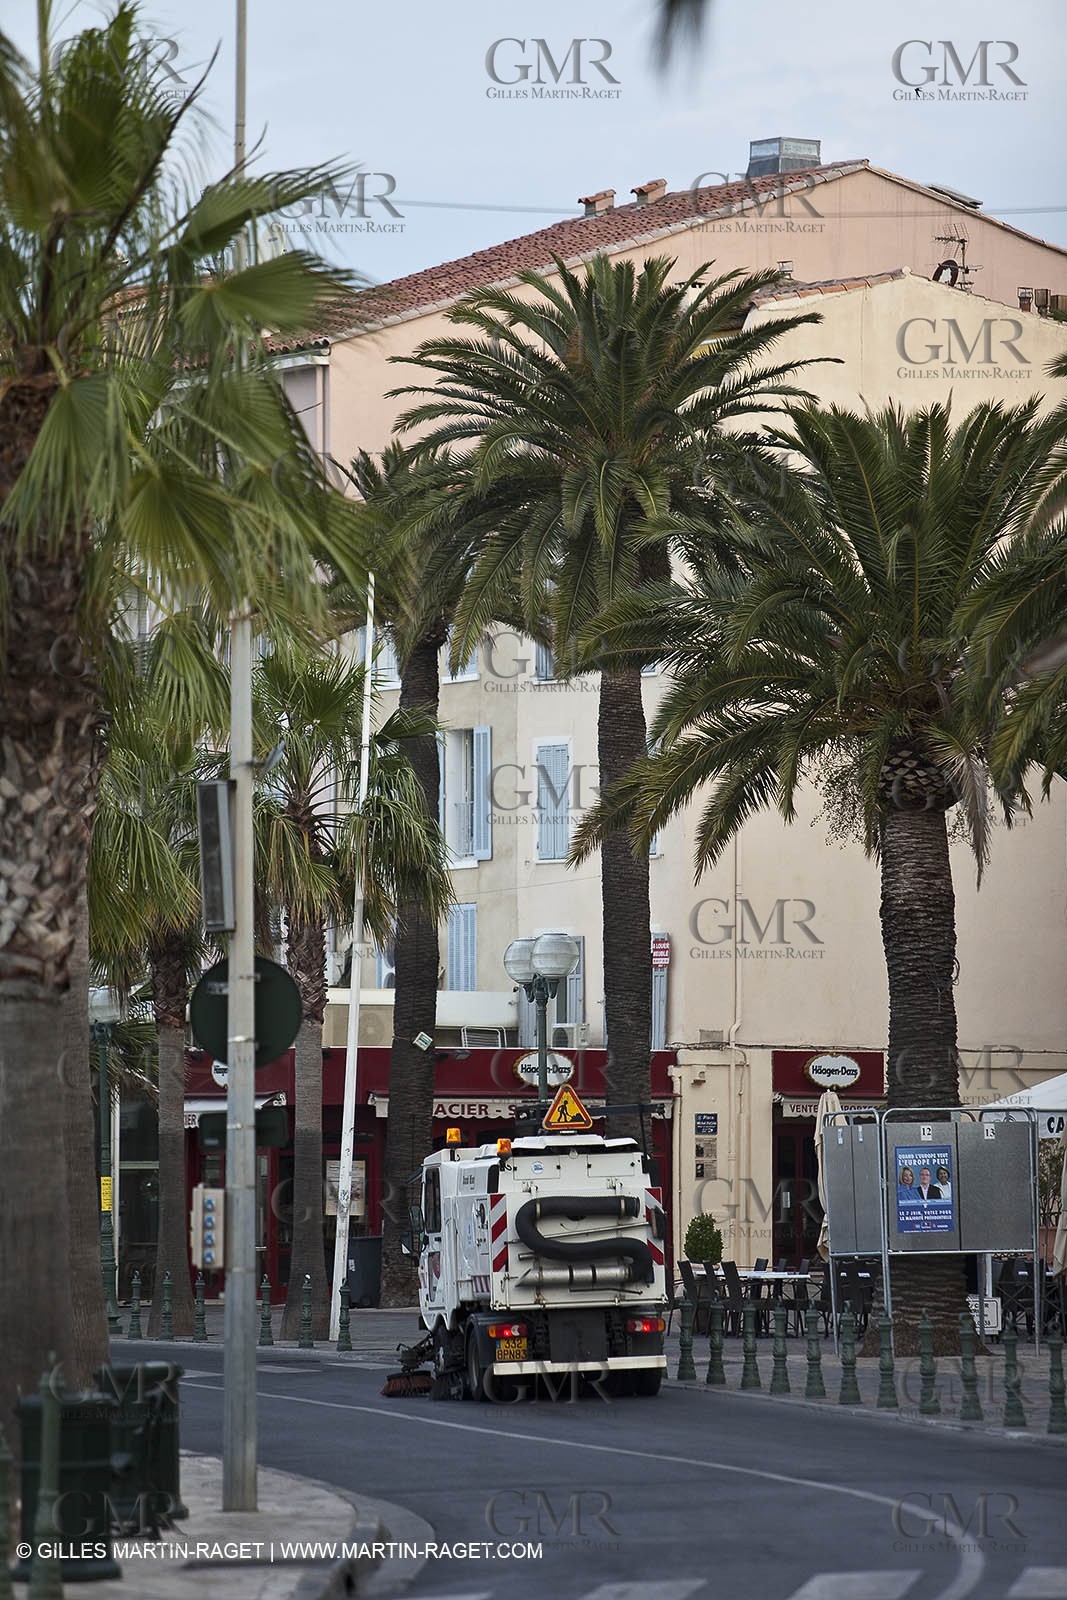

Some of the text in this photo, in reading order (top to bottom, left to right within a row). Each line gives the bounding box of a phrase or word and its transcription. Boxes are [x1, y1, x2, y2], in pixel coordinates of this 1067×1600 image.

[520, 1064, 571, 1078] Häagn-Dazs
[812, 1065, 858, 1078] Häagen-Dazs
[434, 1103, 488, 1115] ACIER
[508, 1103, 517, 1115] S
[790, 1104, 818, 1113] VENTE
[1047, 1117, 1064, 1133] CA
[921, 1127, 932, 1136] 12
[985, 1128, 996, 1137] 13
[504, 1338, 522, 1348] 332
